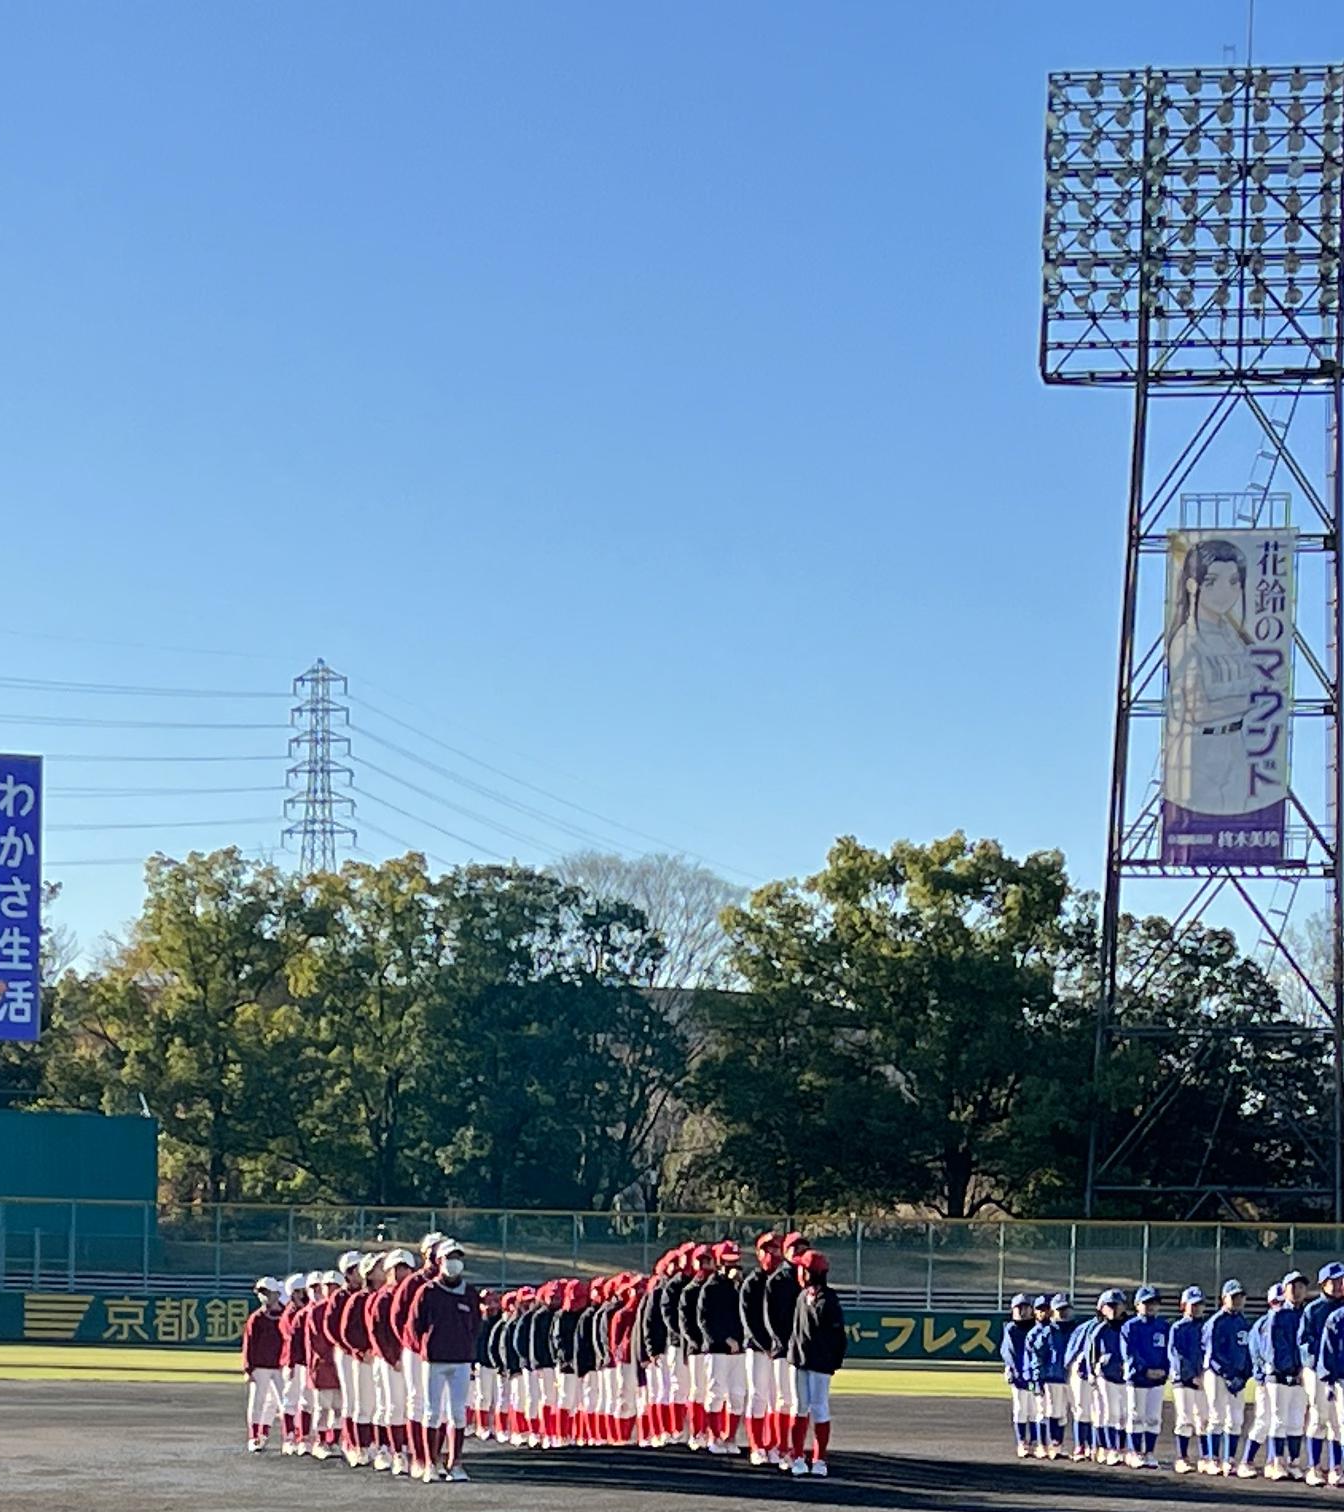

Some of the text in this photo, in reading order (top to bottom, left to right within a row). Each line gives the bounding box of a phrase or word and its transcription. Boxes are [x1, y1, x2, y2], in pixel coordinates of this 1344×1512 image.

[1247, 540, 1288, 798] 花鈴のマウンド
[102, 1296, 250, 1342] 京都銀
